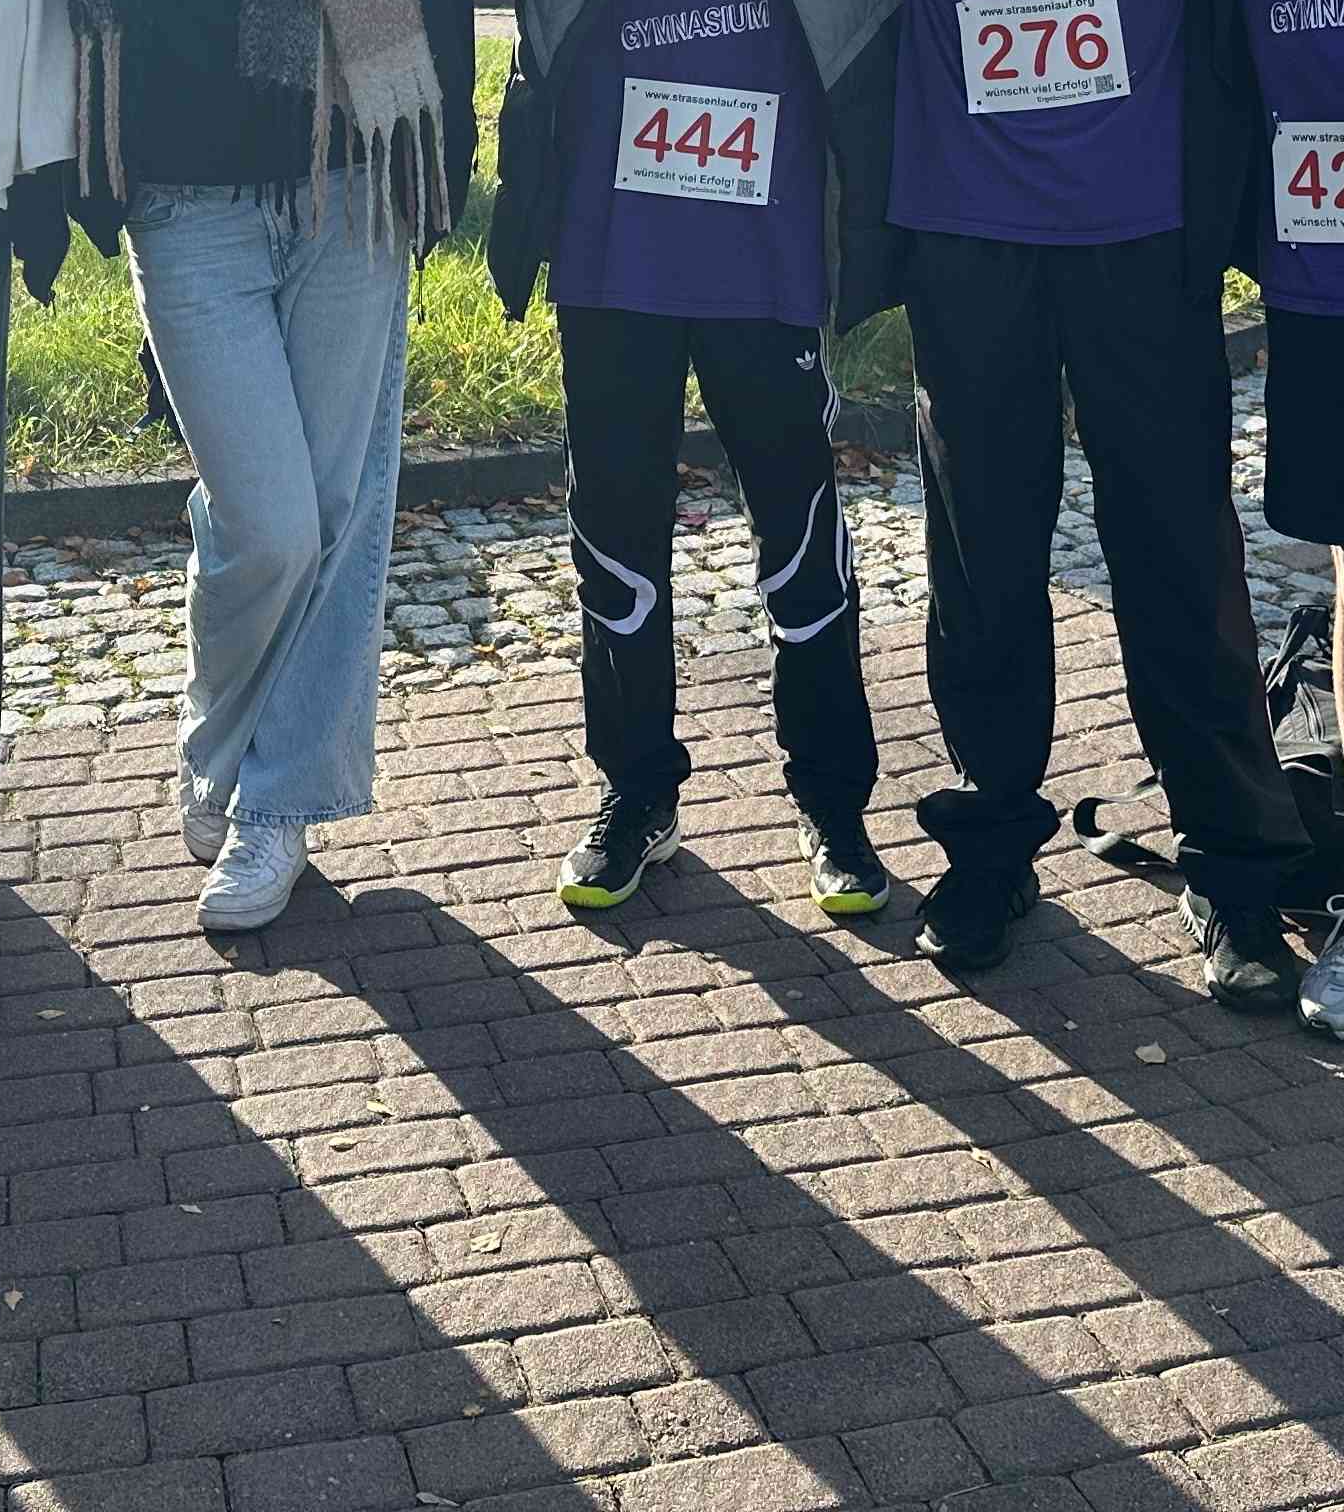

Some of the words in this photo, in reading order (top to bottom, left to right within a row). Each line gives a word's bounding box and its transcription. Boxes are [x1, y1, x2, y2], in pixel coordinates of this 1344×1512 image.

[621, 0, 770, 51] GYMNASIUM
[978, 14, 1109, 81] 276
[985, 85, 1030, 98] wünscht
[1032, 83, 1052, 94] viel
[1054, 77, 1093, 92] Erfolg!
[644, 90, 759, 113] www.strassenlauf.org
[633, 107, 760, 173] 444
[633, 167, 676, 181] wünscht
[678, 174, 697, 184] viel
[699, 174, 735, 188] Erfolg!
[1292, 216, 1338, 228] wünscht
